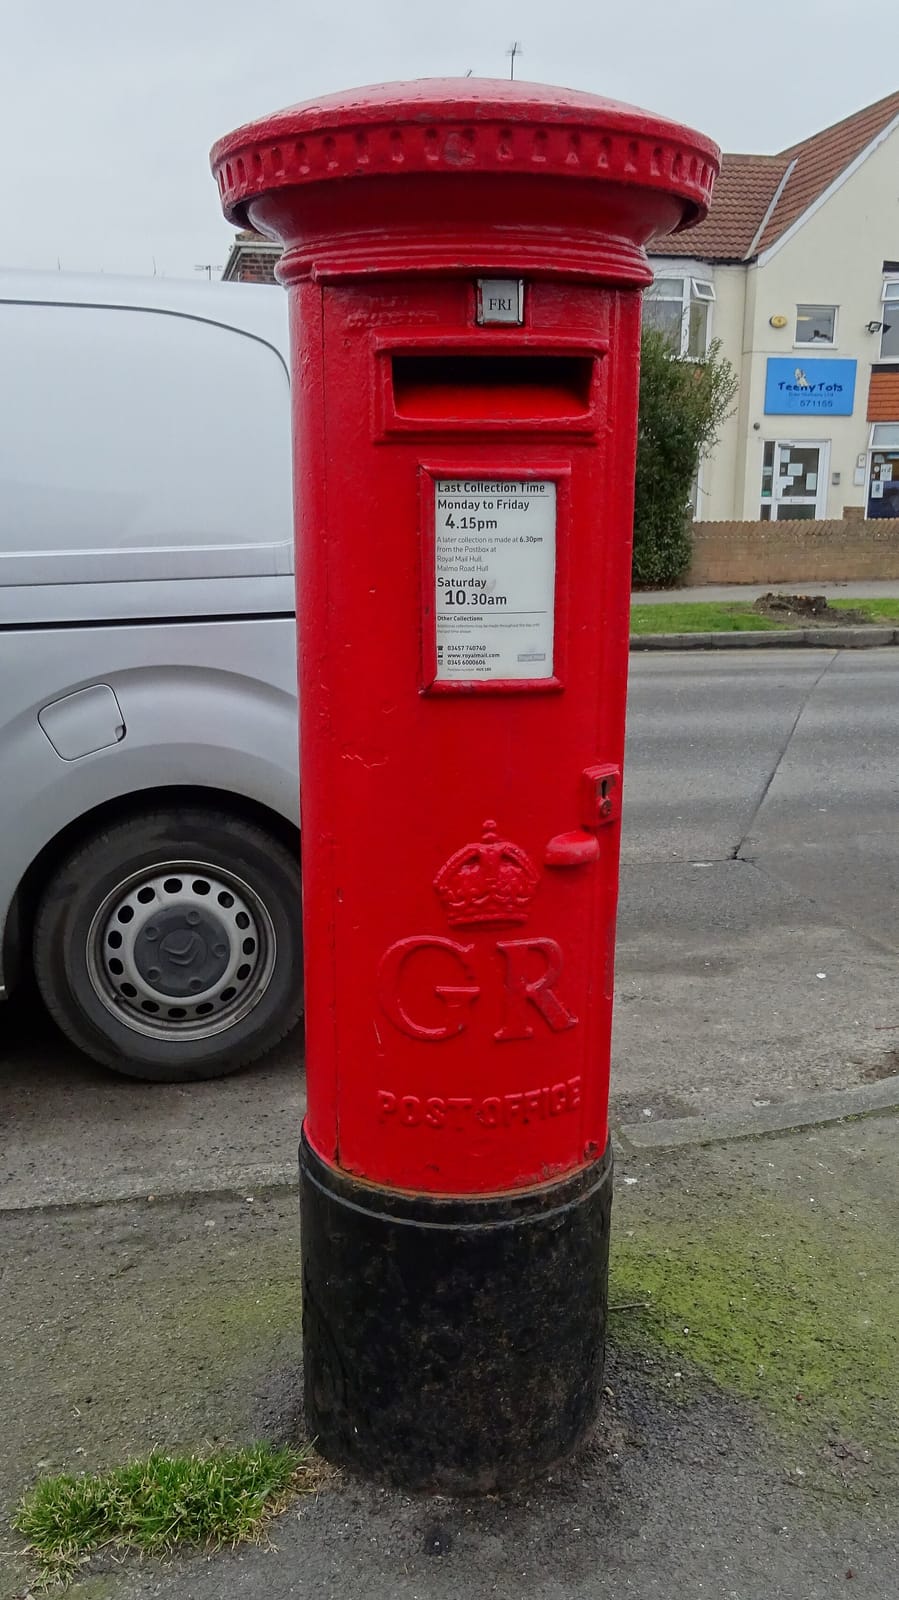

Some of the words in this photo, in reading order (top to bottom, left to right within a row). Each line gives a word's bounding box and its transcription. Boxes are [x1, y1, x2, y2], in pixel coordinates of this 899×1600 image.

[489, 298, 512, 311] FRI
[778, 381, 816, 392] Teeny
[818, 382, 843, 392] Tots
[437, 482, 461, 493] Last
[464, 482, 517, 493] Collection
[519, 482, 545, 493] Time
[437, 499, 480, 511] Monday
[483, 500, 494, 510] to
[496, 499, 530, 511] Friday
[445, 513, 498, 531] 4.15pm
[519, 536, 543, 544] 6.30pm
[437, 577, 487, 589] Saturday
[445, 590, 507, 605] 10.30am
[377, 934, 580, 1042] GR
[377, 1089, 473, 1131] POST
[481, 1076, 581, 1129] OFFICE
